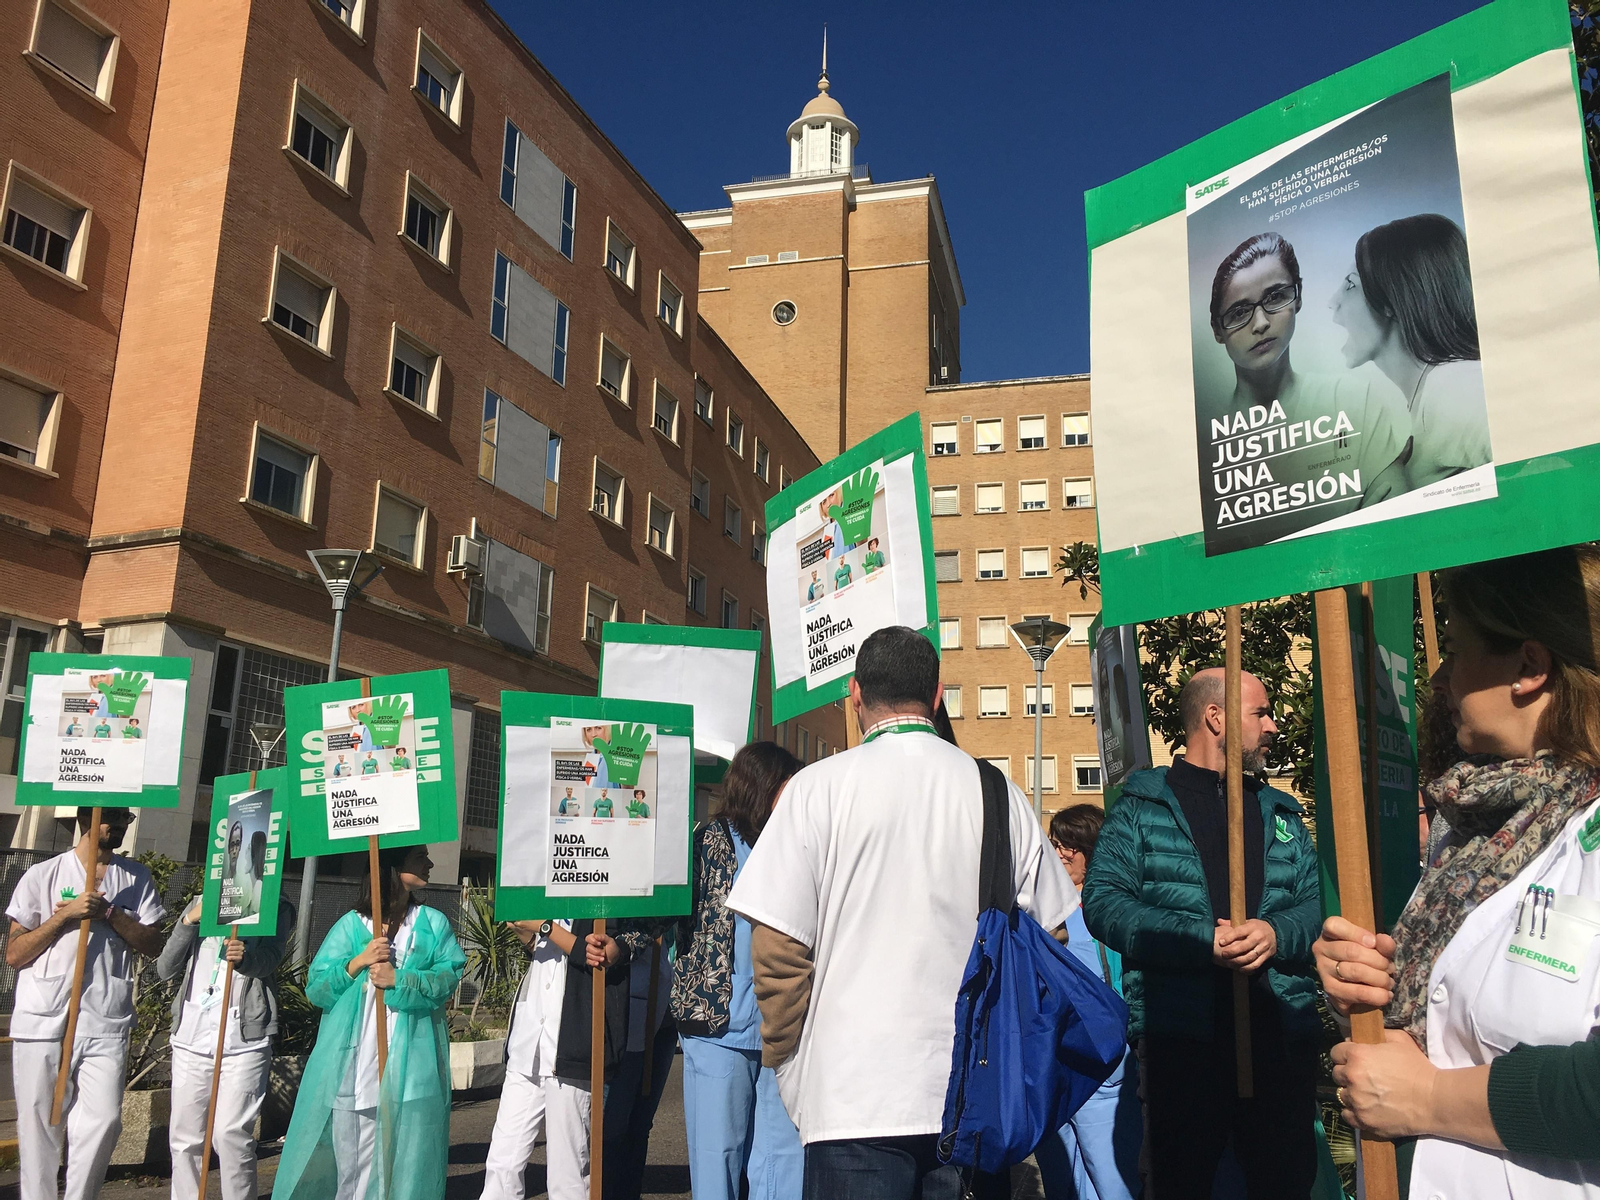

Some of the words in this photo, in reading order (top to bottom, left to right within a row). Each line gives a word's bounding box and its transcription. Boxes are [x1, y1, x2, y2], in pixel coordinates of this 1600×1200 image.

[1239, 193, 1251, 204] EL
[1252, 186, 1270, 199] 80%
[1271, 178, 1284, 191] DE
[1285, 171, 1302, 184] LAS
[1304, 134, 1389, 175] ENFERMERAS/OS
[1247, 195, 1267, 210] HAN
[1268, 178, 1308, 201] SUFRIDO
[1310, 168, 1332, 183] UNA
[1332, 145, 1382, 175] AGRESIÓN
[1194, 176, 1230, 199] SATSE
[1274, 188, 1303, 207] FÍSICA
[1304, 184, 1313, 194] O
[1313, 171, 1351, 190] VERBAL
[1268, 205, 1298, 223] #STOP
[1299, 179, 1360, 212] AGRESIONES
[1210, 399, 1287, 440] NADA
[1212, 410, 1354, 468] JUSTIFICA
[1213, 462, 1274, 495] UNA
[1216, 468, 1362, 525] AGRESIÓN
[1422, 486, 1445, 498] Sindicato
[806, 614, 832, 635] NADA
[807, 617, 853, 647] JUSTIFICA
[808, 643, 829, 660] UNA
[810, 644, 856, 674] AGRESIÓN
[608, 749, 640, 760] AGRESIONES
[616, 745, 634, 753] #STOP
[59, 757, 105, 765] JUSTIFICA
[59, 765, 79, 773] UNA
[58, 773, 105, 783] AGRESIÓN
[331, 789, 358, 799] NADA
[332, 797, 378, 810] JUSTIFICA
[332, 810, 353, 819] UNA
[333, 815, 379, 829] AGRESIÓN
[554, 834, 585, 844] NADA
[553, 847, 609, 858] JUSTIFICA
[553, 859, 578, 870] UNA
[551, 869, 609, 882] AGRESIÓN
[222, 878, 234, 887] NADA
[221, 886, 244, 896] JUSTIFICA
[220, 897, 231, 906] UNA
[219, 904, 242, 915] AGRESIÓN
[1508, 943, 1576, 975] ENFERMERA
